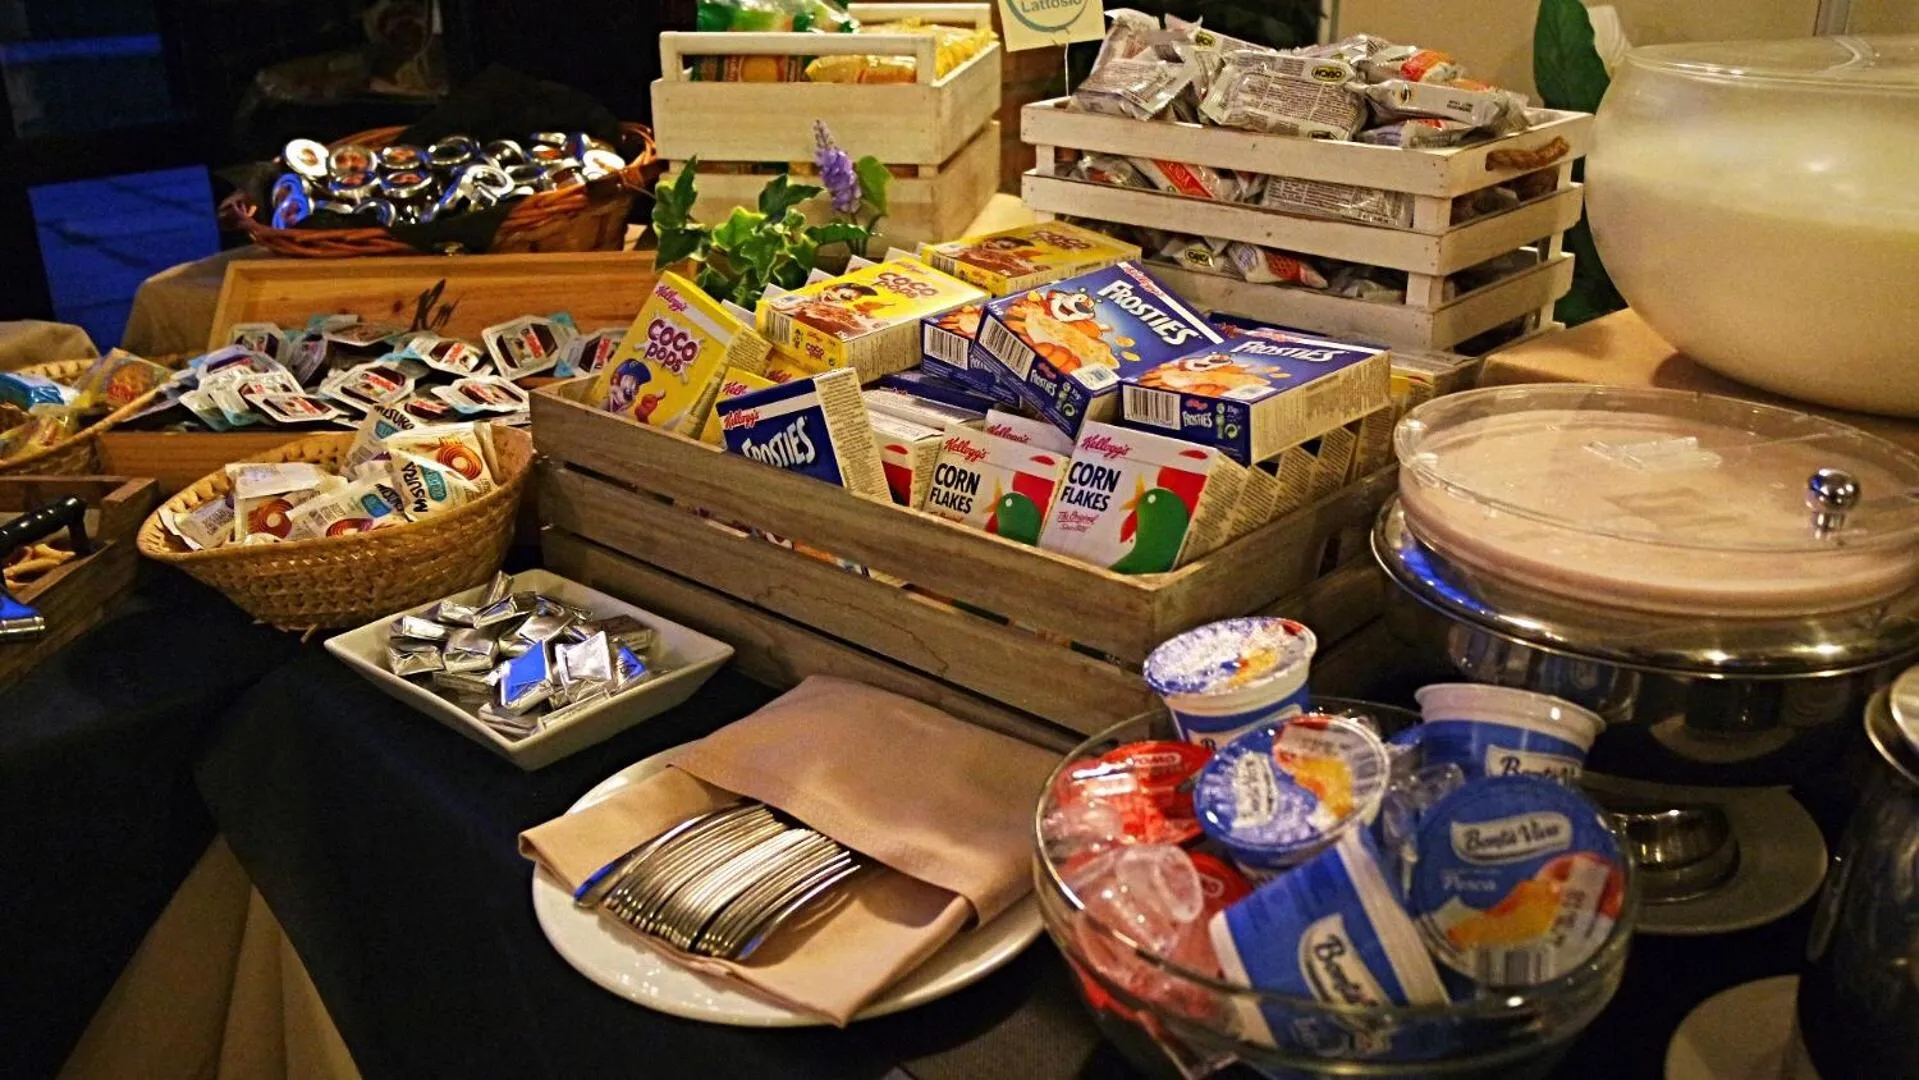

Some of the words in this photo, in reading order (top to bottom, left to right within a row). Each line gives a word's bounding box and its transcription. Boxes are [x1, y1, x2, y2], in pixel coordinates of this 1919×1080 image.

[1096, 280, 1200, 346] FROSTIES
[647, 318, 698, 362] COCO
[1230, 341, 1346, 362] FROSTIES
[642, 341, 684, 373] pops
[943, 436, 990, 463] Kellogg's
[1081, 433, 1133, 460] Kellogg's
[934, 463, 981, 496] CORN
[1068, 461, 1121, 493] CORN
[929, 487, 973, 515] FLAKES
[1060, 486, 1111, 512] FLAKES
